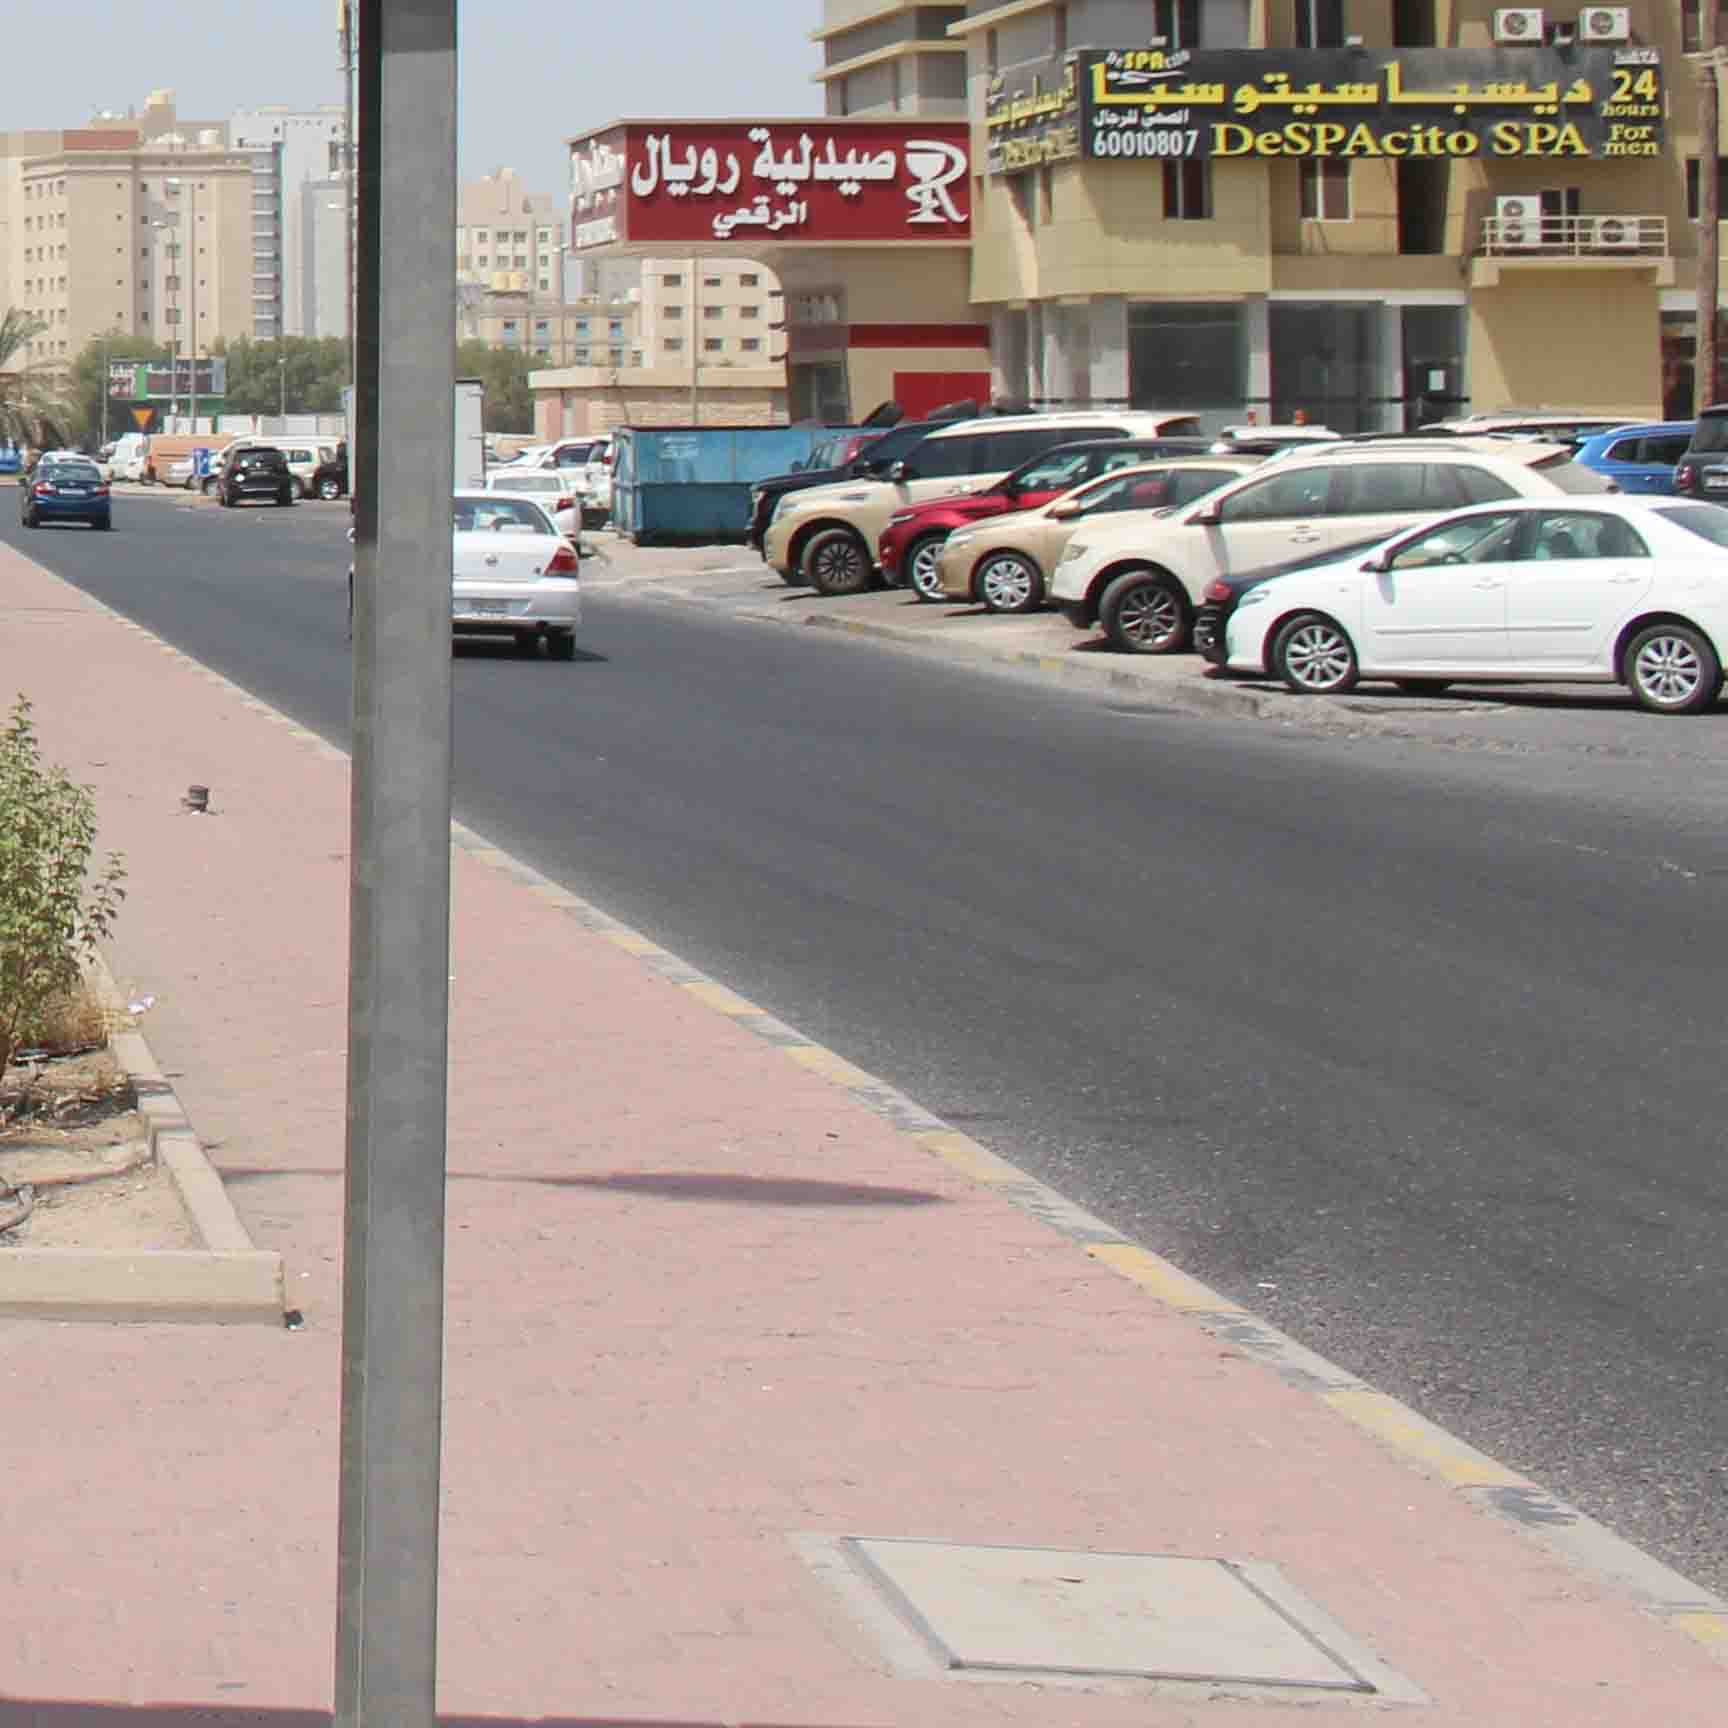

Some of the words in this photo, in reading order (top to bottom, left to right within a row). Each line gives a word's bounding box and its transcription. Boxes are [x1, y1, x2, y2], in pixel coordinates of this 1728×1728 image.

[1609, 69, 1660, 102] 24
[1601, 101, 1661, 118] hours
[1094, 129, 1200, 157] 60010807
[1210, 121, 1480, 157] DeSPAcito
[1491, 121, 1592, 156] SPA
[1603, 141, 1659, 156] men
[1608, 123, 1653, 141] For
[632, 134, 740, 196] رويال
[748, 128, 897, 195] صيدلية
[712, 194, 808, 239] الرقعي
